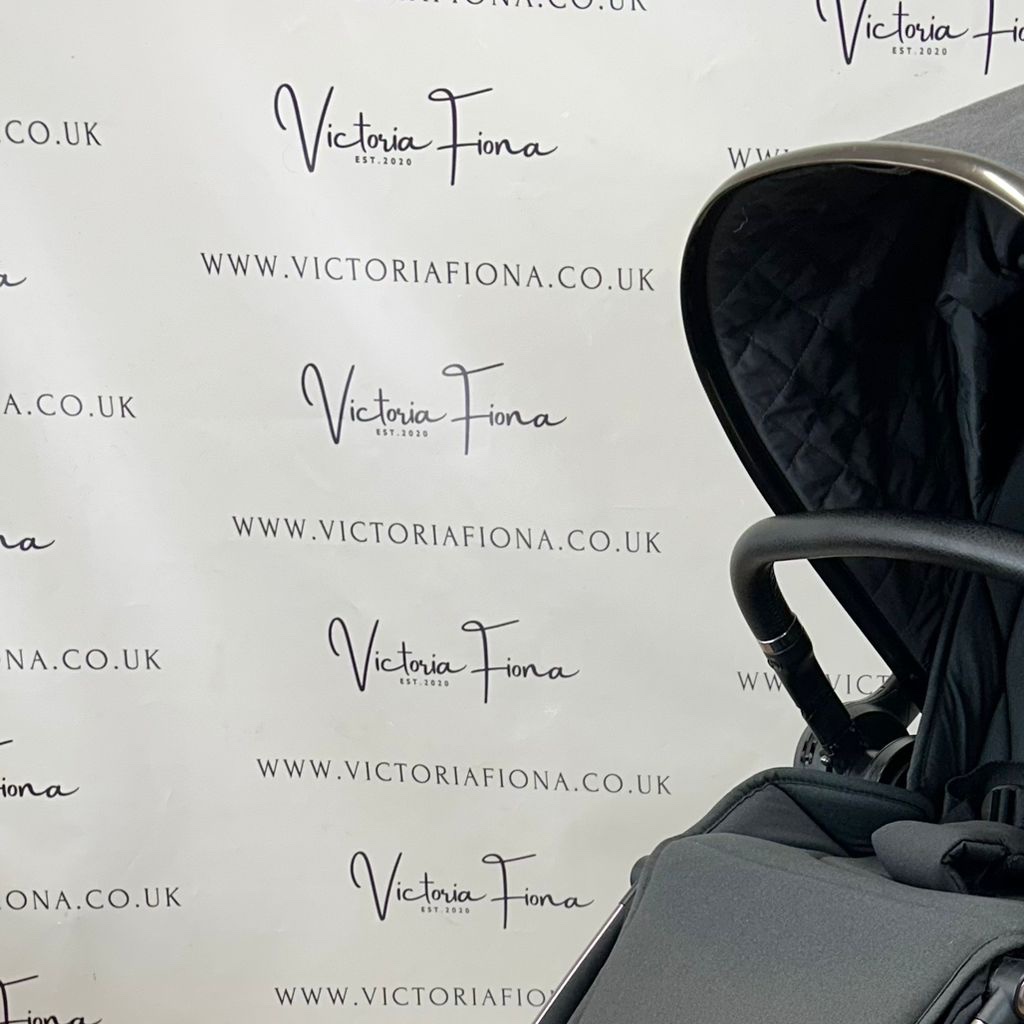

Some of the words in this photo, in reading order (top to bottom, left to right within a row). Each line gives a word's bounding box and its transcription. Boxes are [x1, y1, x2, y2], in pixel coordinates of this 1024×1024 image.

[816, 0, 969, 65] Victoria
[892, 47, 947, 55] EST.2020
[0, 120, 101, 146] CO.UK
[274, 83, 432, 173] Victoria
[428, 88, 558, 186] Fiona
[355, 156, 412, 166] EST.2020
[200, 253, 655, 291] WWW.VICTORIAFIONA.CO.UK
[301, 363, 447, 445] Victoria
[442, 363, 567, 455] Fiona
[376, 429, 428, 437] EST.2020
[232, 516, 661, 553] WWW.VICTORIAFIONA.CO.UK
[328, 617, 467, 692] Victoria
[461, 620, 580, 704] Fiona
[257, 759, 671, 795] WWW.VICTORIAFIONA.CO.UK
[0, 887, 181, 910] ONA.CO.UK
[350, 851, 486, 921] Victoria
[481, 853, 594, 929] Fiona
[274, 987, 554, 1007] WWW.VICTORIAFIO
